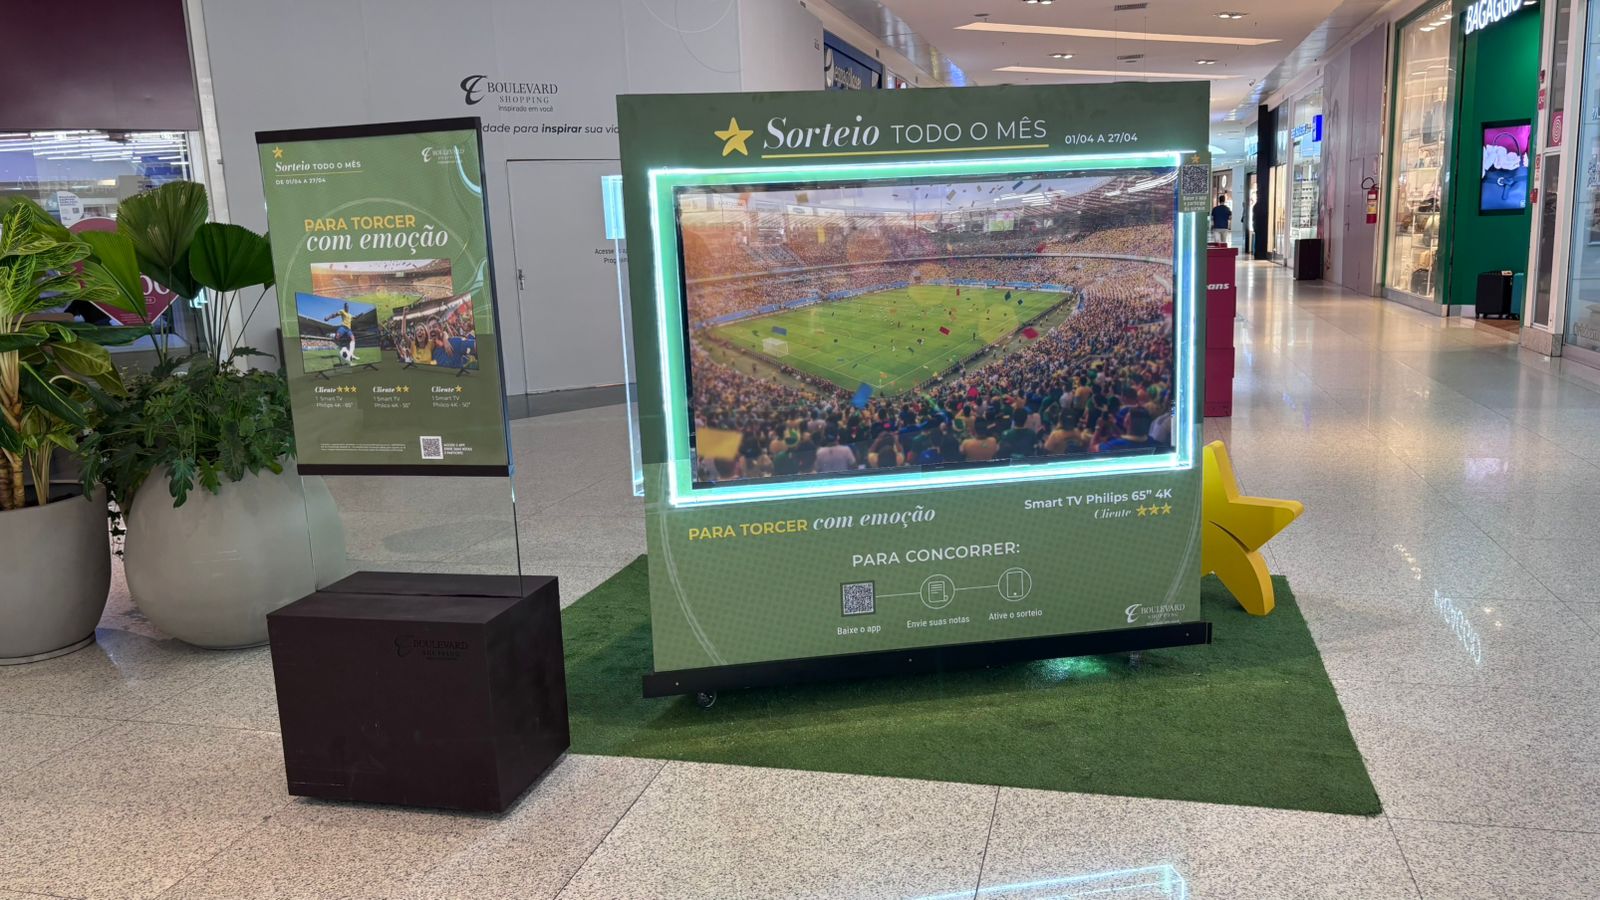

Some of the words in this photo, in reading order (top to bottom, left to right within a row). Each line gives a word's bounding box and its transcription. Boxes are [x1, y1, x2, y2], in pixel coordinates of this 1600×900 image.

[487, 82, 558, 95] BOULEVARD
[499, 96, 549, 104] SHOPPING
[498, 105, 527, 113] Inspirado
[513, 124, 539, 135] para
[541, 123, 582, 136] inspirar
[584, 125, 602, 134] sua
[763, 114, 880, 150] Sorteio
[890, 122, 962, 144] TODO
[969, 121, 988, 141] O
[997, 116, 1047, 140] MÊS
[1064, 134, 1094, 145] 01/04
[1096, 134, 1105, 143] A
[1107, 132, 1138, 143] 27/04
[274, 161, 311, 172] Sorteio
[345, 160, 362, 169] MÊS
[304, 218, 348, 232] PARA
[351, 214, 416, 230] TORCER
[306, 233, 353, 252] com
[359, 224, 449, 255] emoção
[314, 386, 337, 394] Cliente
[372, 386, 395, 394] Cliente
[431, 386, 455, 394] Cliente
[1024, 497, 1063, 510] Smart
[1065, 495, 1082, 507] TV
[1086, 492, 1129, 506] Philips
[1155, 488, 1172, 500] 4K
[1094, 508, 1132, 520] Cliente
[688, 525, 736, 541] PARA
[739, 519, 808, 536] TORCER
[813, 513, 854, 531] com
[859, 504, 936, 529] emoção
[852, 552, 900, 567] PARA
[905, 541, 1020, 563] CONCORRER:
[988, 611, 1008, 621] Ative
[1016, 608, 1043, 619] sorteio
[1140, 603, 1185, 614] BOULEVARD
[906, 618, 930, 629] Envie
[931, 618, 948, 627] suas
[949, 615, 970, 626] notas
[837, 625, 858, 636] Baixe
[867, 625, 882, 636] app
